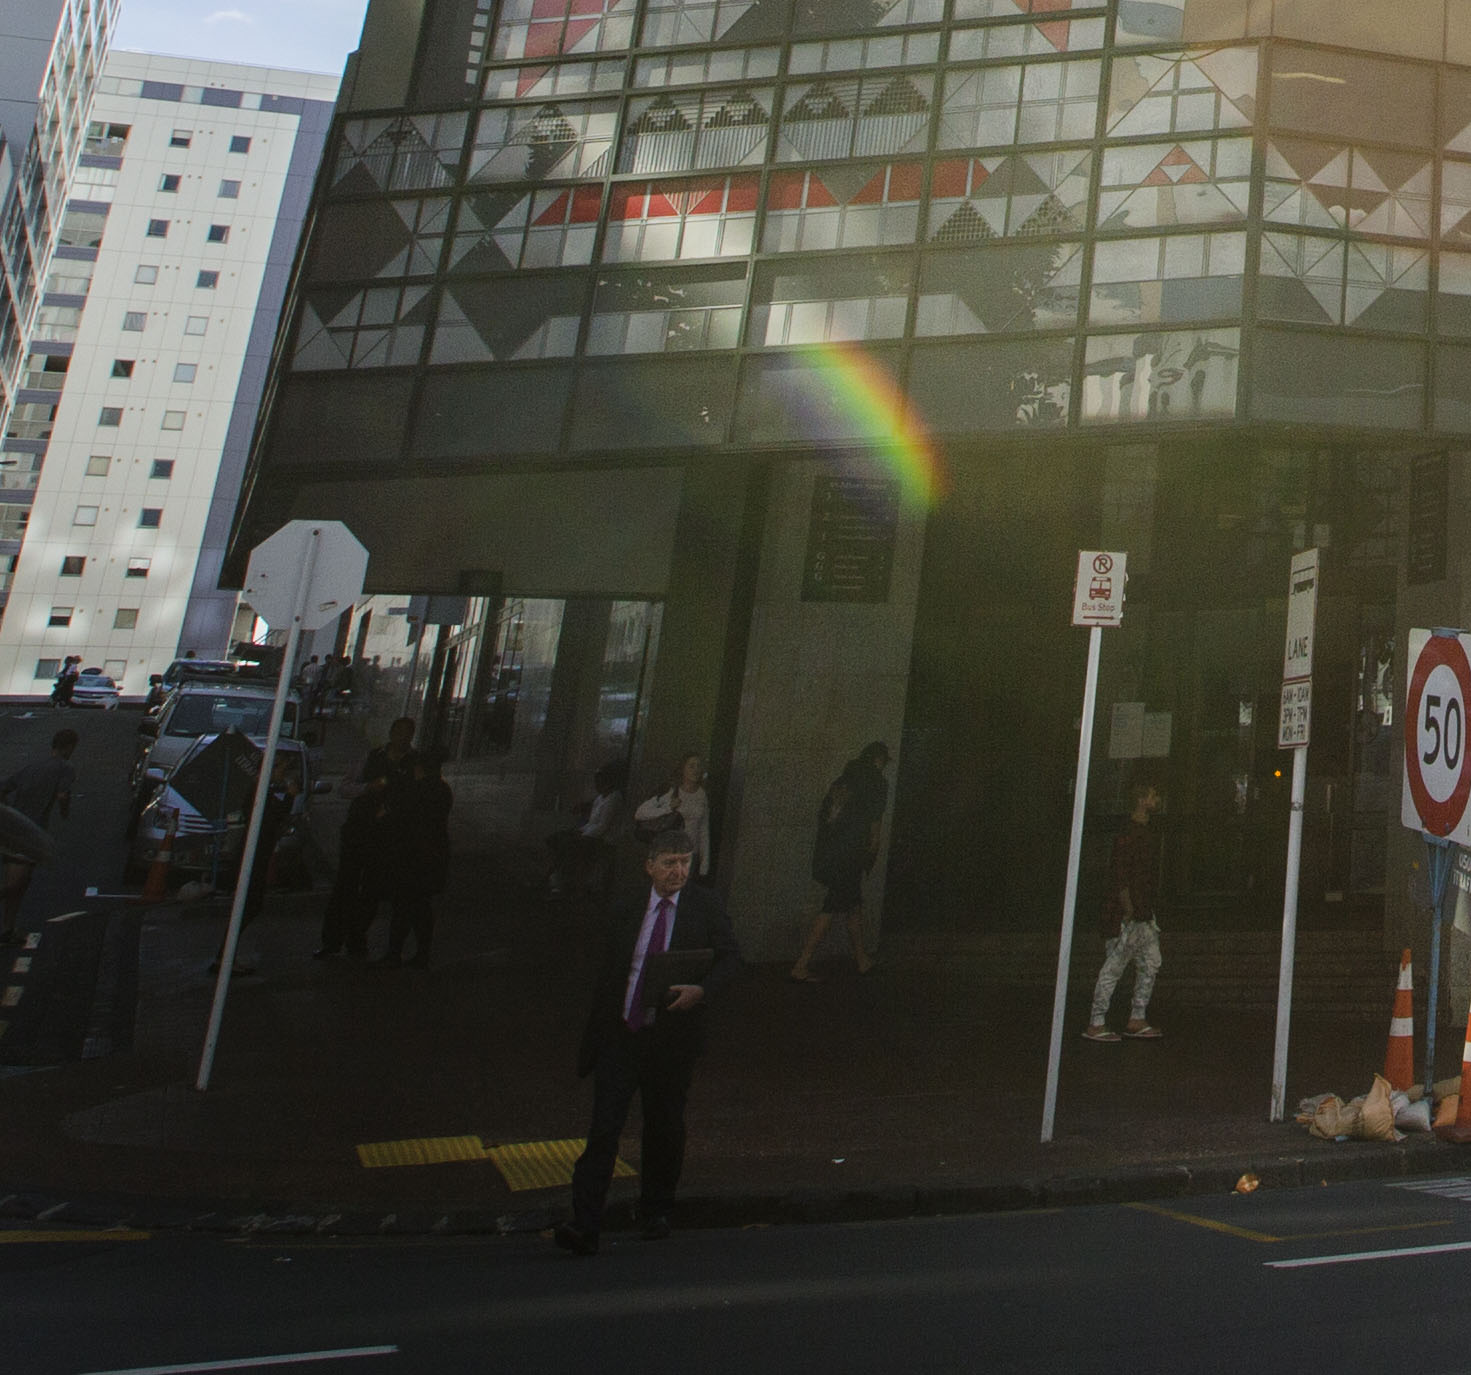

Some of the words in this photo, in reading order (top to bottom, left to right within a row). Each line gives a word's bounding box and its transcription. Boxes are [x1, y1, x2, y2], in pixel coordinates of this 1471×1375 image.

[1081, 602, 1096, 611] Bus
[1098, 603, 1115, 612] Stop
[1288, 636, 1308, 660] LANE
[1423, 694, 1461, 770] 50
